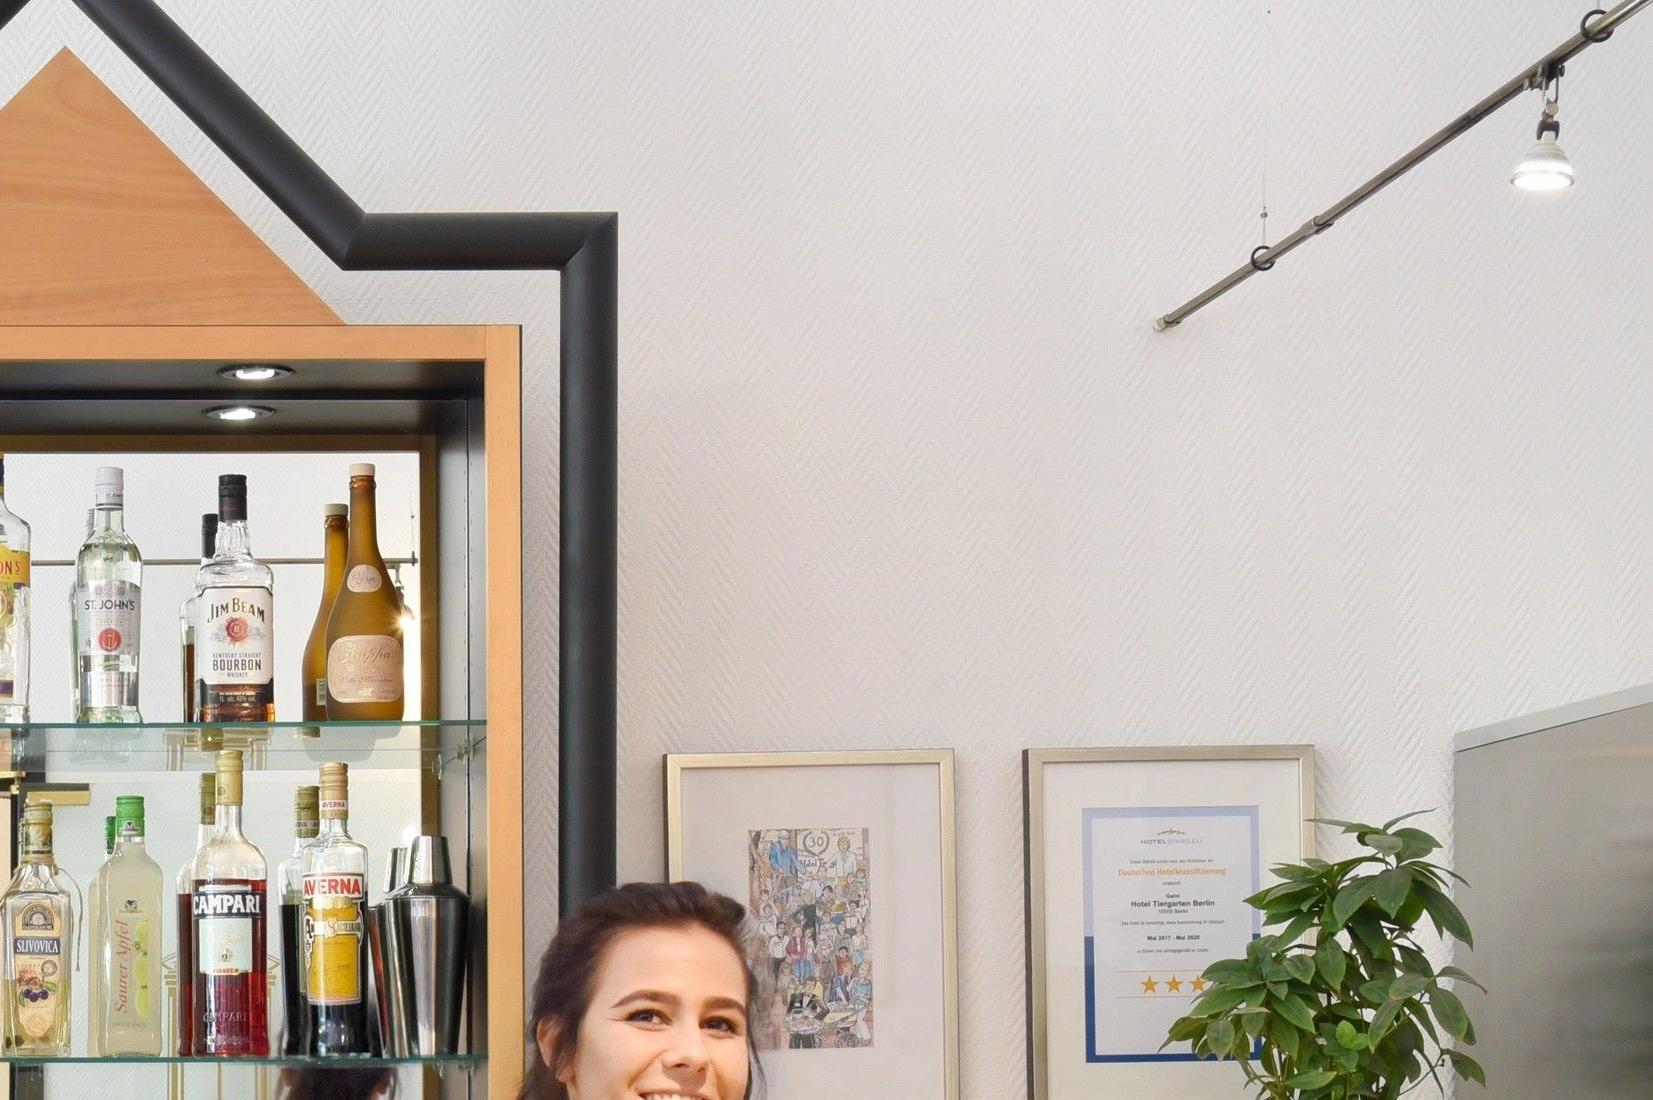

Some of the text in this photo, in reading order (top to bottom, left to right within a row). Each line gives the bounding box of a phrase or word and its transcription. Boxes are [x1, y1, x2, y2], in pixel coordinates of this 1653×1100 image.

[84, 599, 135, 611] ST. JOHN'S
[207, 597, 265, 623] JIM BEAM
[212, 659, 262, 671] BOURBON
[808, 836, 825, 848] 30
[1118, 868, 1155, 876] Deutschen
[303, 878, 361, 896] AVERNA
[193, 894, 261, 915] CAMPARI
[1153, 900, 1191, 909] Tiergarten
[16, 939, 59, 954] SLIVOVICA
